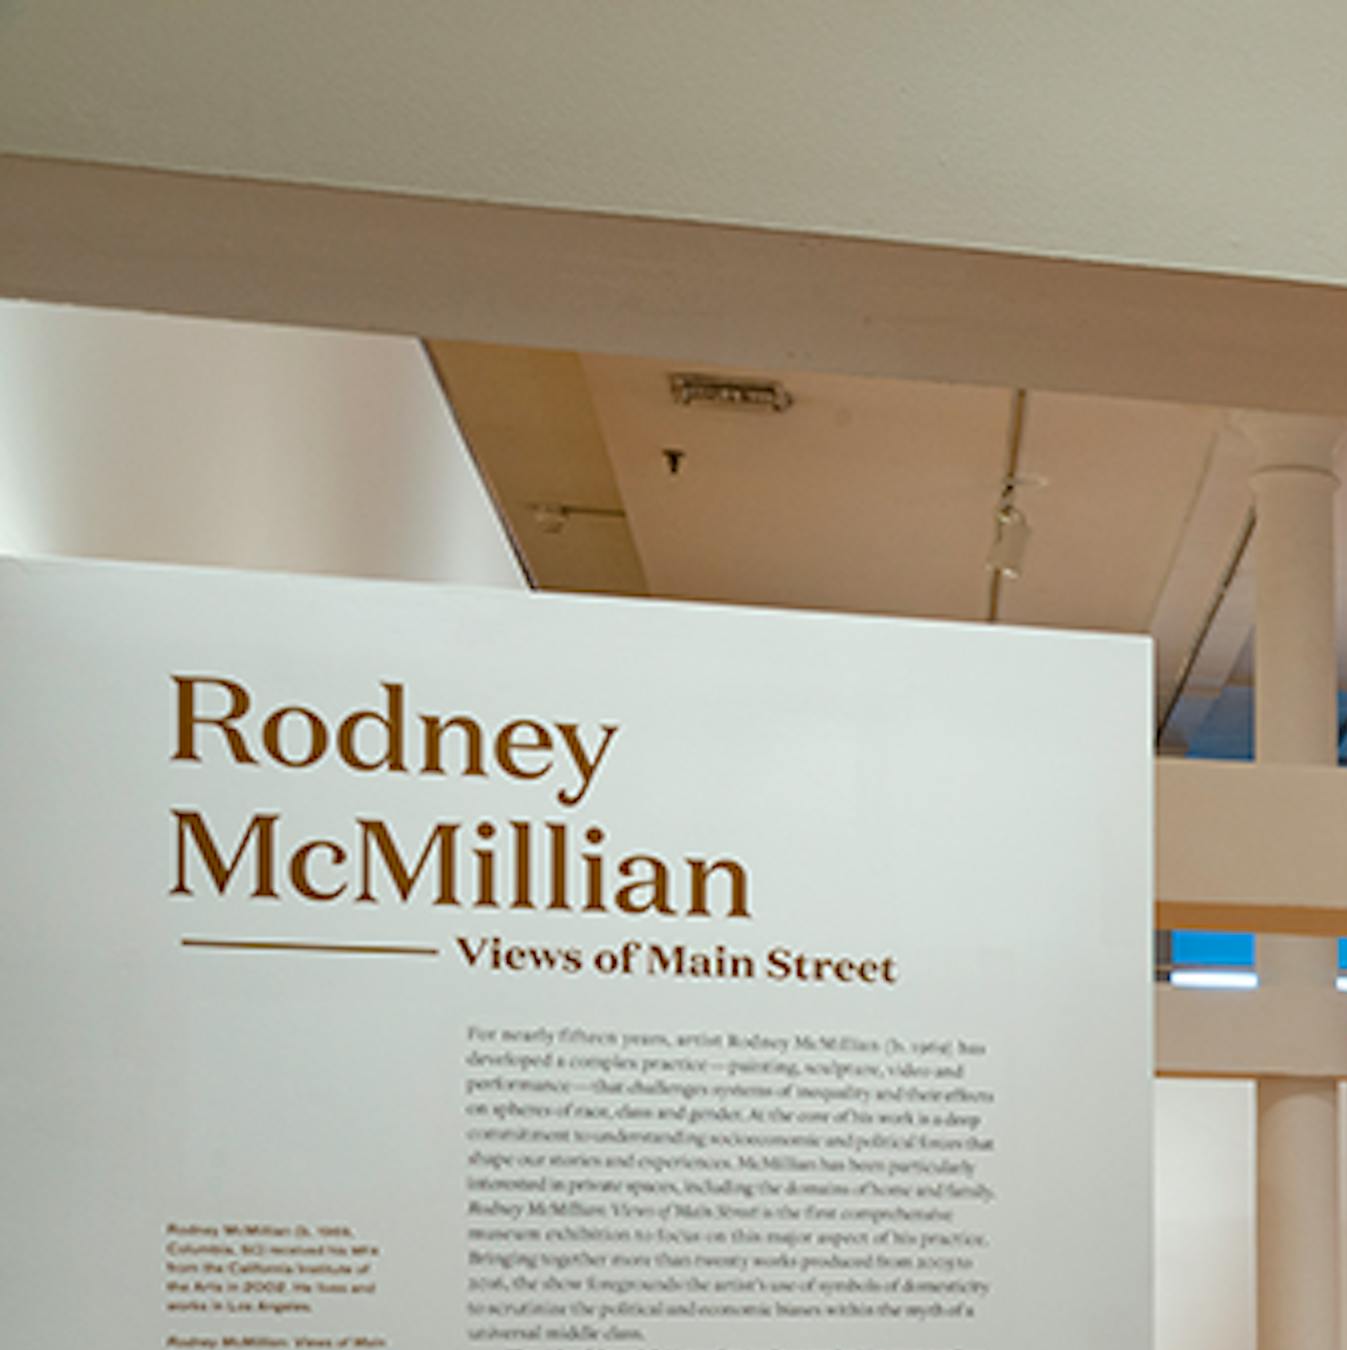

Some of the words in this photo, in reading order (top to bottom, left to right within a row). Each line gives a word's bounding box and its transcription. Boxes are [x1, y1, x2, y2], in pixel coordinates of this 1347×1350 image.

[171, 674, 619, 808] Rodney
[169, 808, 752, 920] McMillian
[456, 936, 584, 974] Views
[592, 942, 643, 975] of
[647, 944, 757, 979] Main
[766, 947, 898, 985] Street
